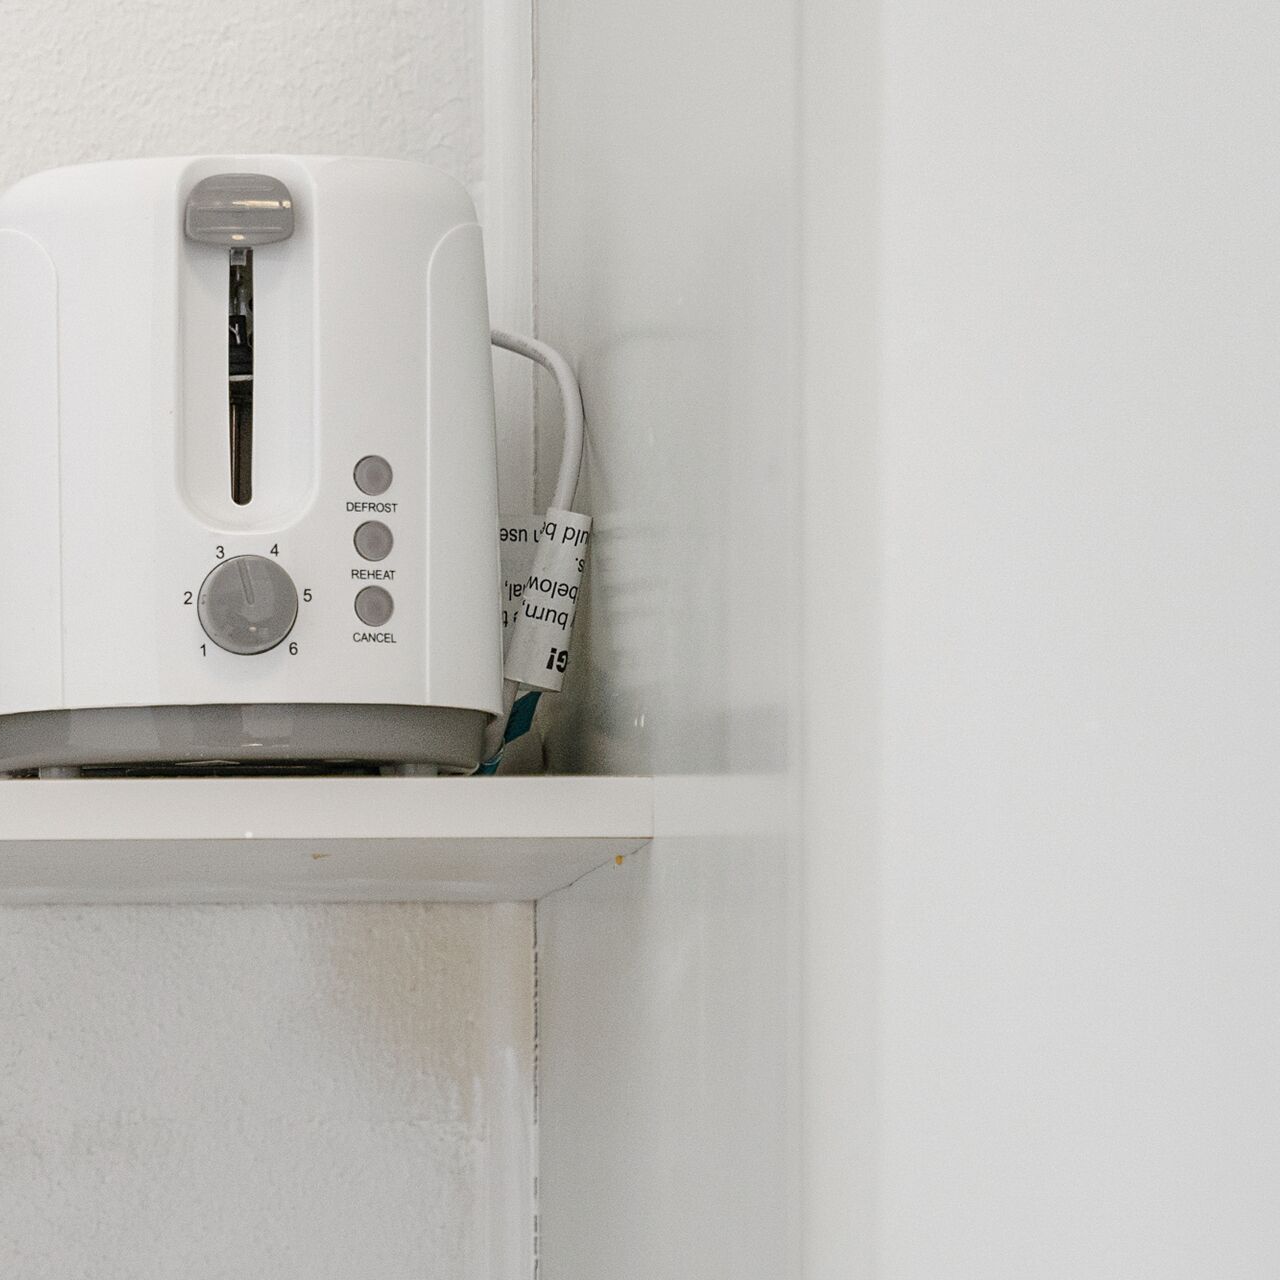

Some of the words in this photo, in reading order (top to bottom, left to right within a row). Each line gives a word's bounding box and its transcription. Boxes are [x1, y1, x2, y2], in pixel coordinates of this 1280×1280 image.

[346, 502, 398, 513] DEFROST
[216, 546, 225, 559] 3
[270, 544, 279, 556] 4
[351, 570, 396, 580] REHEAT
[527, 576, 578, 601] below
[184, 592, 193, 605] 2
[303, 589, 312, 602] 5
[522, 600, 568, 630] burn,
[353, 633, 397, 643] CANCEL
[200, 644, 206, 656] 1
[289, 642, 298, 655] 6
